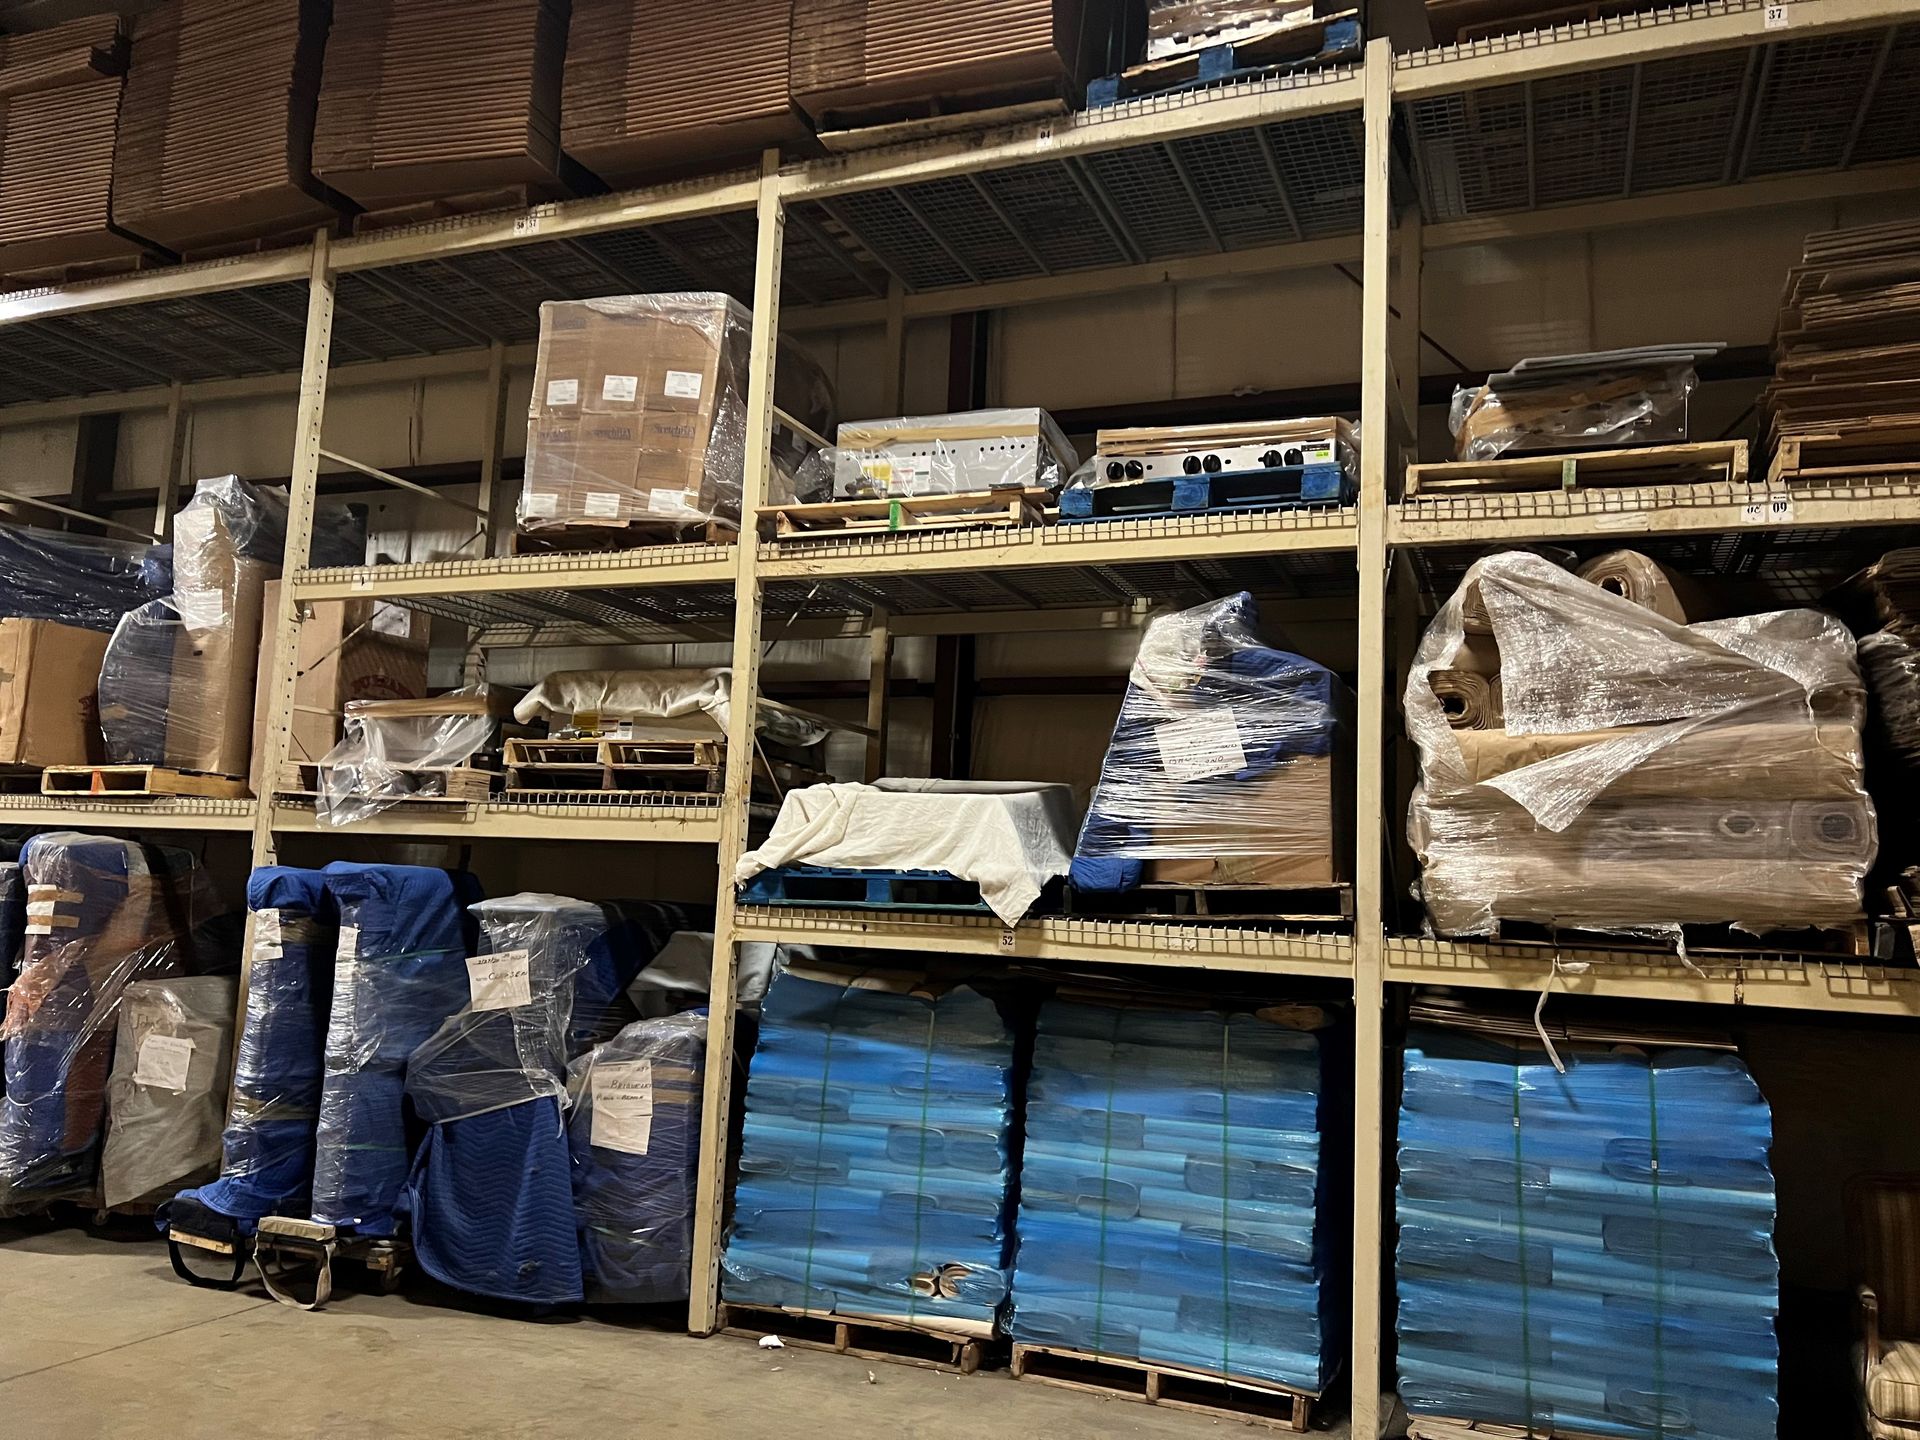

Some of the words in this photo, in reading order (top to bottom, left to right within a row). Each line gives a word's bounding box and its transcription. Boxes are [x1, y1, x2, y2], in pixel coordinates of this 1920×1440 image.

[1768, 8, 1782, 19] 37
[1772, 501, 1787, 513] 09
[1002, 935, 1013, 946] 52
